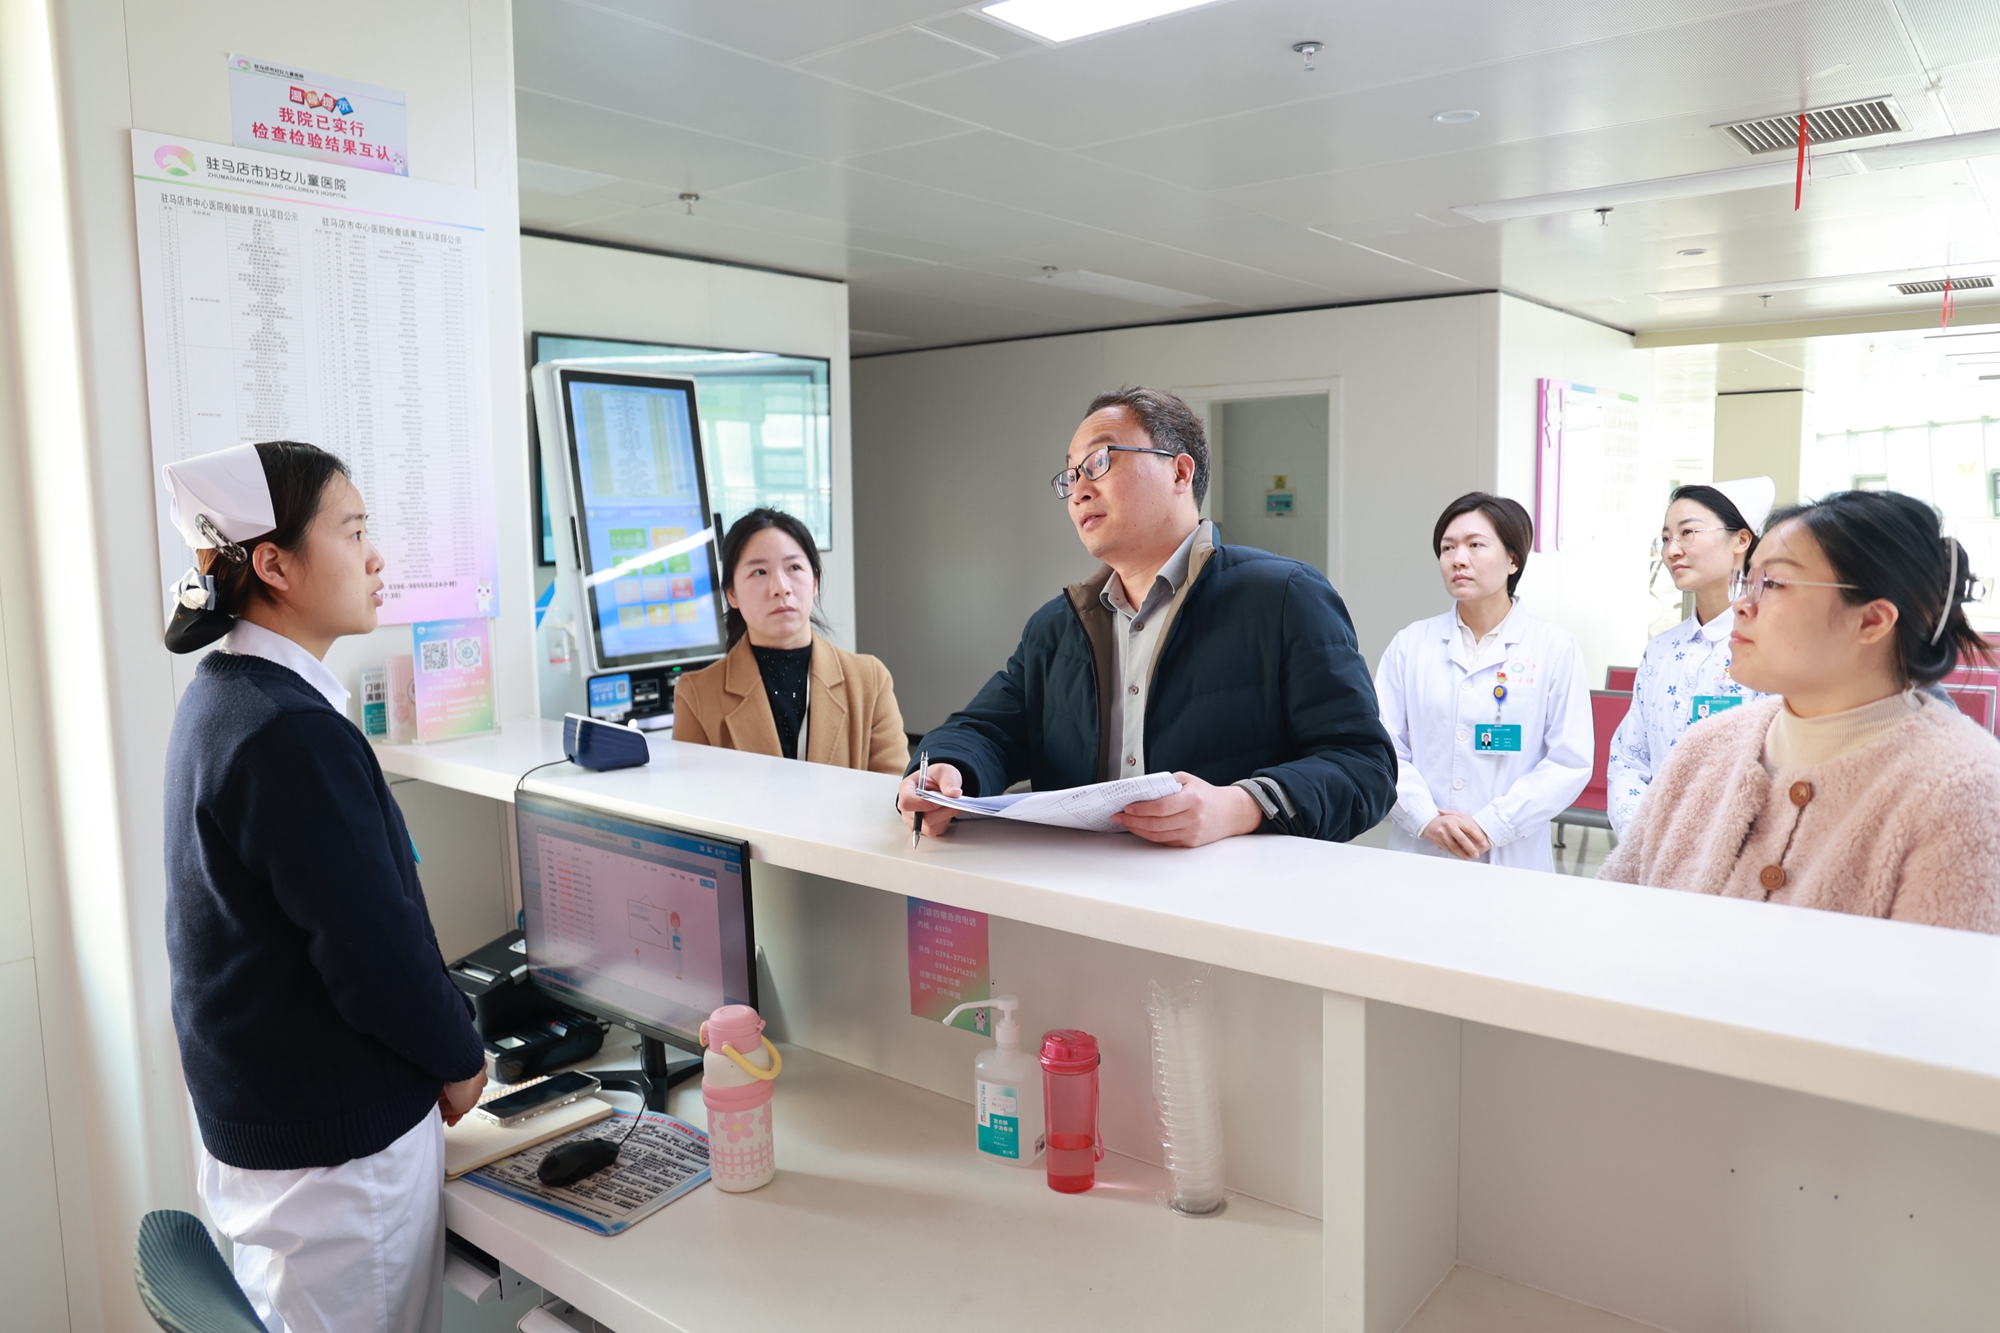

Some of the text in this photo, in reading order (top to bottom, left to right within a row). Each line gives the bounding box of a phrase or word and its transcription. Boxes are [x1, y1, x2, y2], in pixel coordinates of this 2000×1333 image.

[290, 88, 350, 112] 温馨提示
[279, 107, 365, 138] 我院已实行
[252, 121, 390, 162] 检查检验结果互认
[206, 156, 347, 192] 驻马店市妇女儿童医院
[207, 172, 348, 199] ZHUMADIAN WOMEN AND CHILDREN'S HOSPITAL
[161, 193, 299, 222] 驻马店市中心医院检验结果互认项目公示
[321, 216, 462, 245] 驻马店市中心医院检查结果互认项目公示
[918, 906, 977, 927] 门诊四楼急救电话
[935, 937, 954, 948] 65236
[934, 962, 977, 978] 0396-2716236
